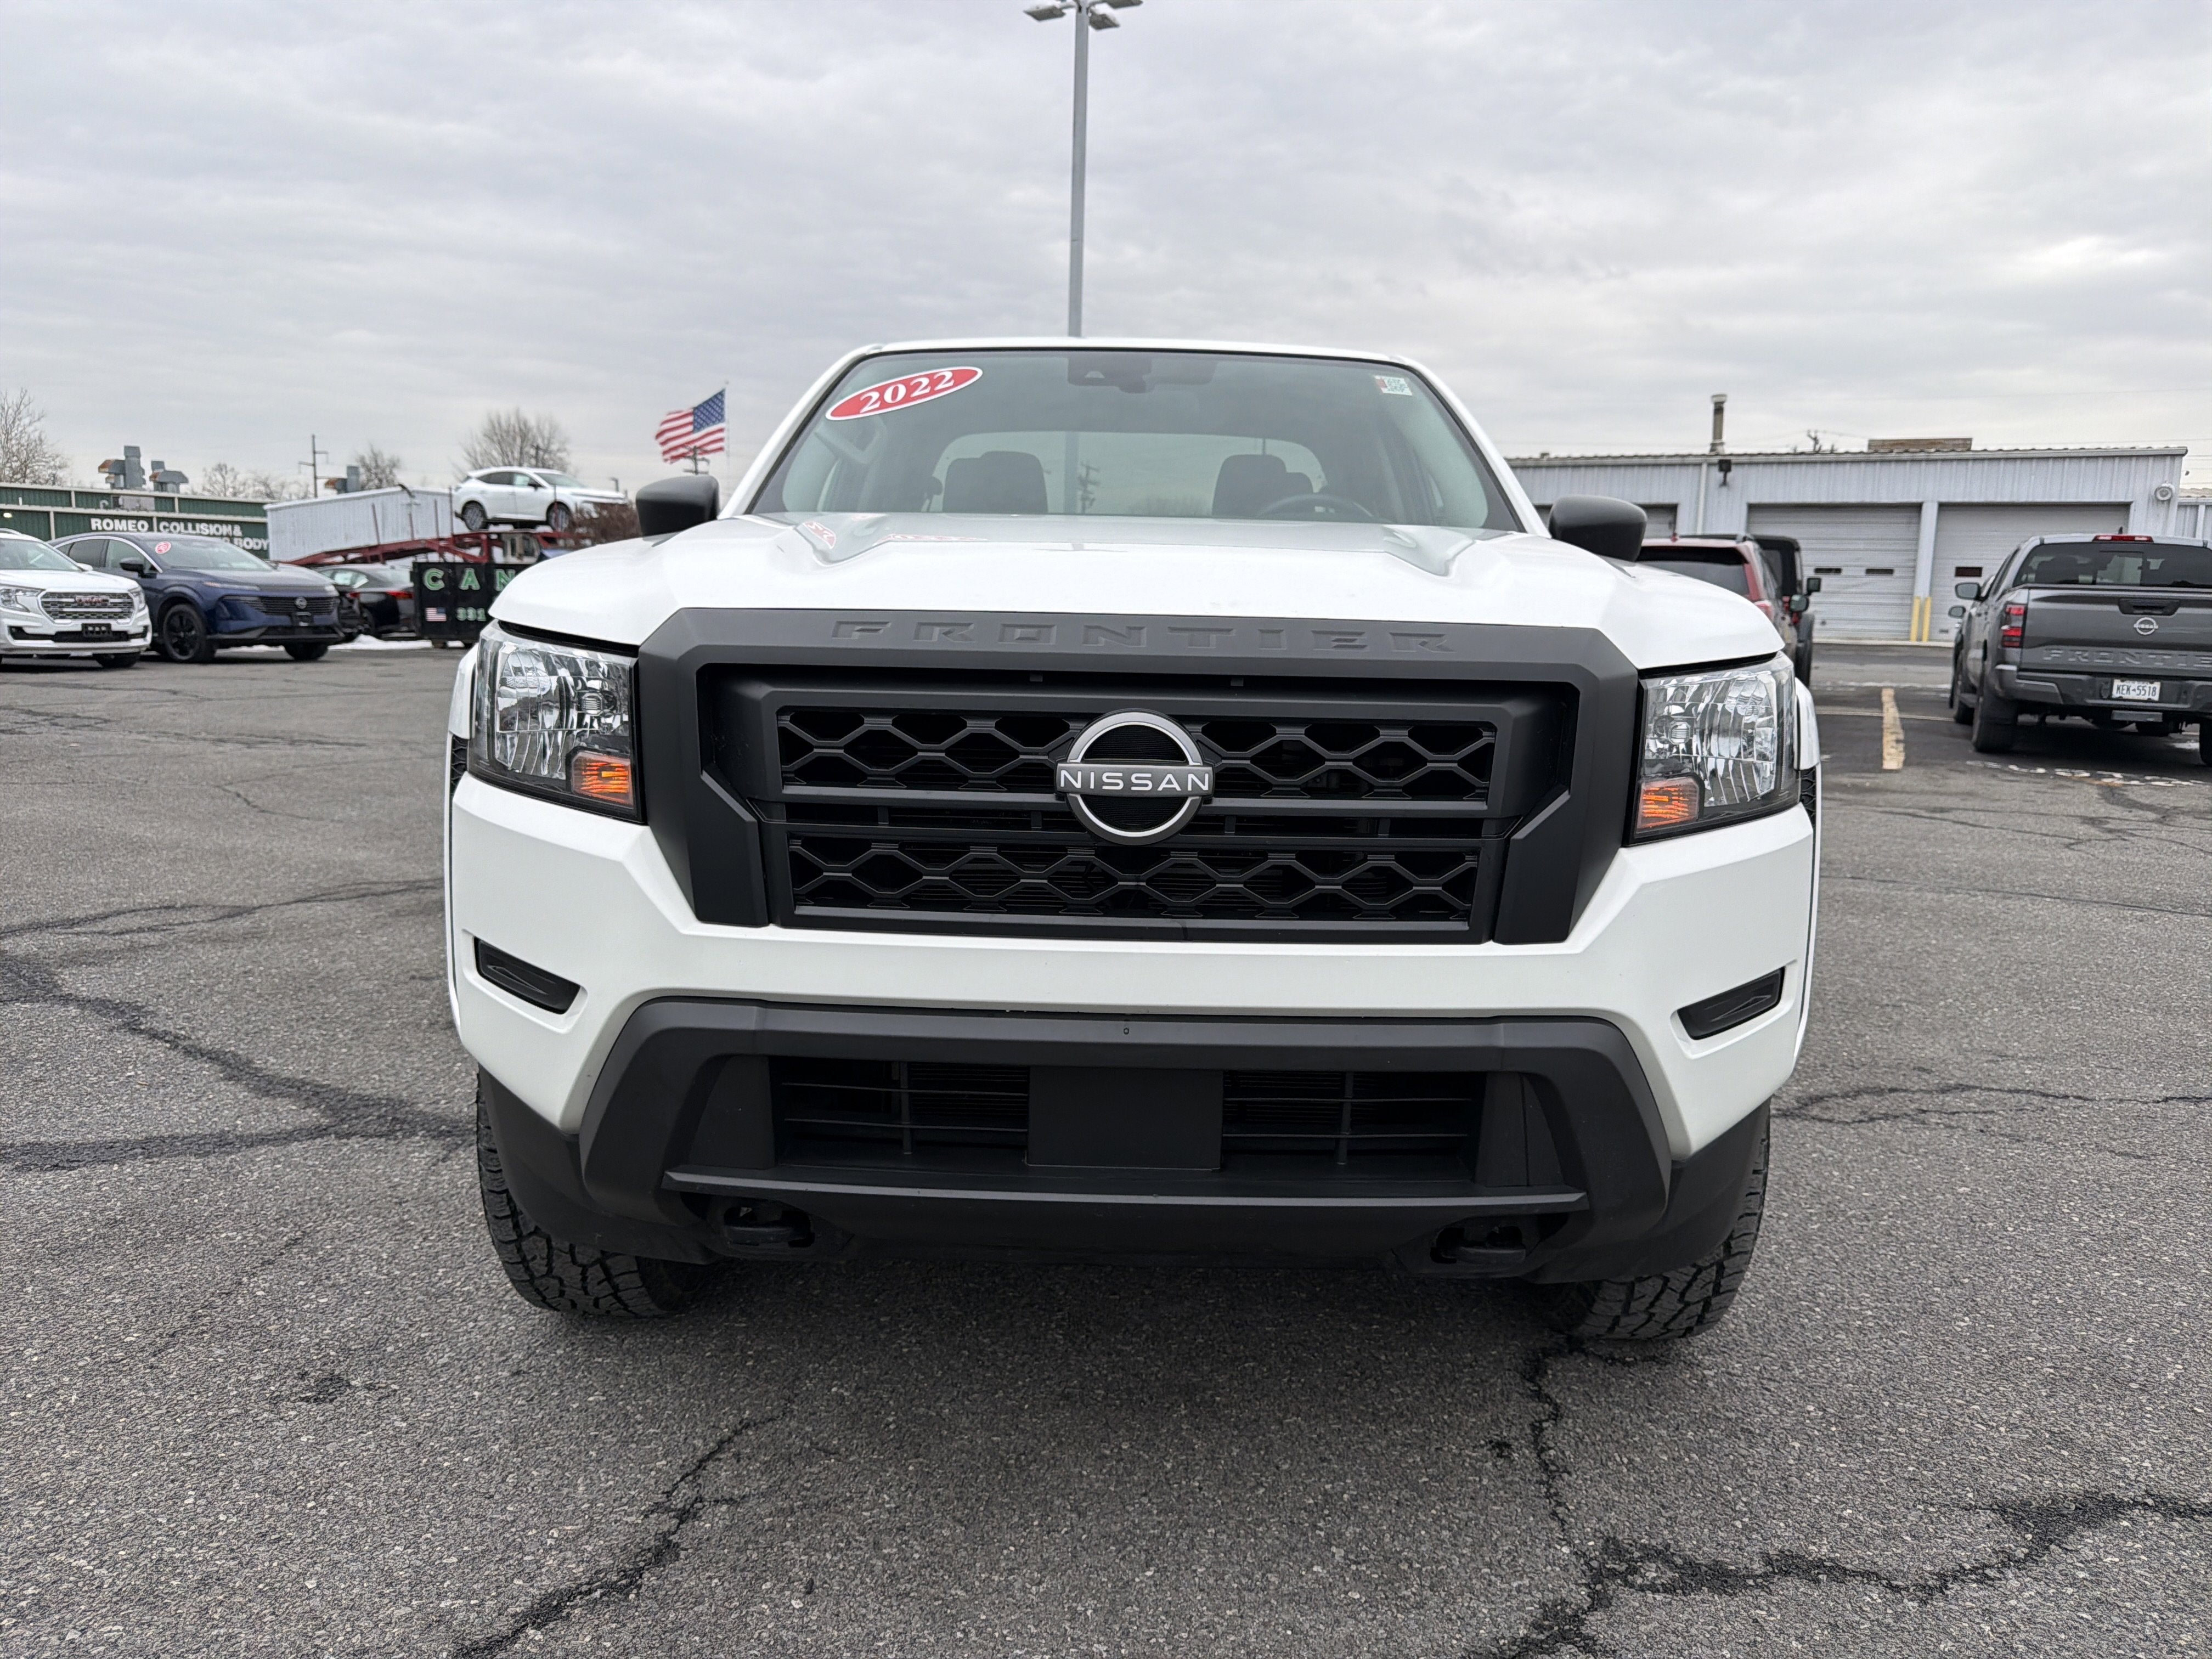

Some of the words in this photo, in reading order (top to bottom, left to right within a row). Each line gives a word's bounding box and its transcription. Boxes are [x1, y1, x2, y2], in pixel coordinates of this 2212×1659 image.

[859, 370, 955, 414] 2022
[91, 518, 149, 532] ROMEO
[159, 521, 232, 536] COLLISION
[233, 524, 242, 537] &
[831, 620, 1457, 653] FRONTIER
[1060, 770, 1209, 792] NISSAN
